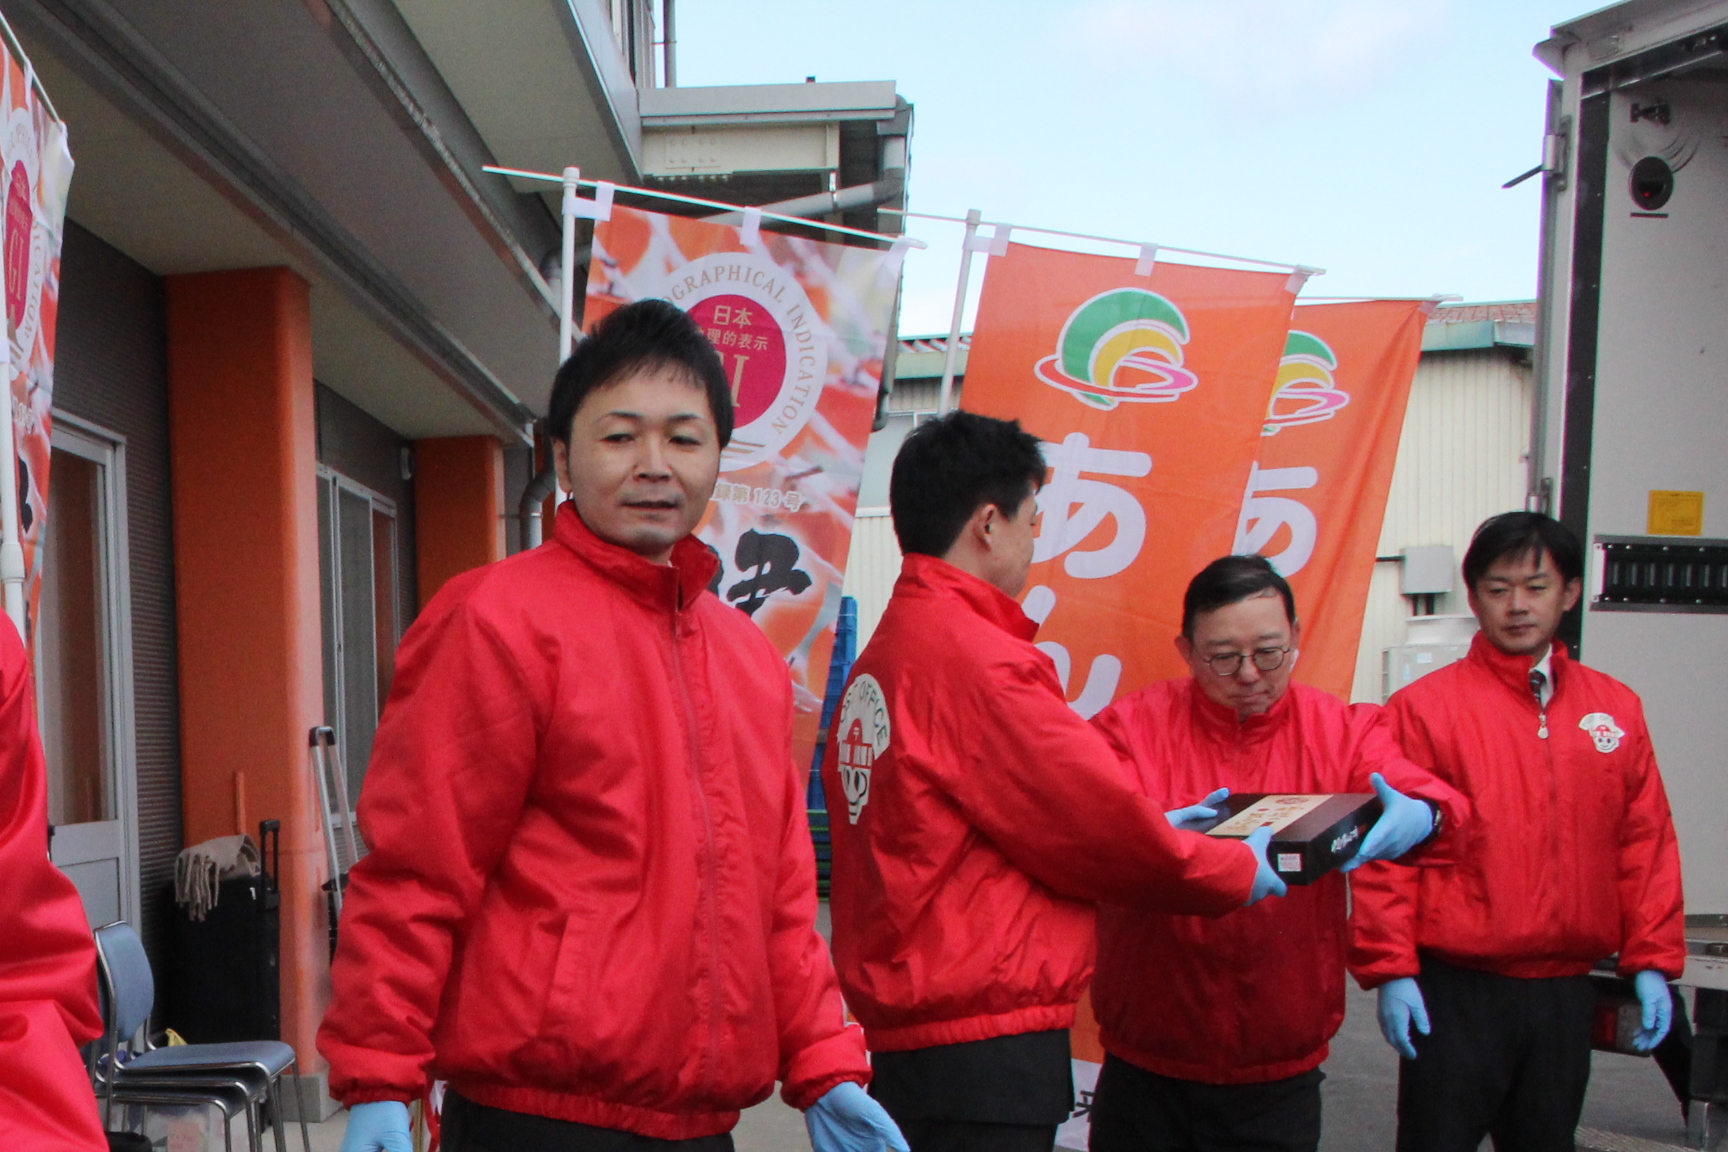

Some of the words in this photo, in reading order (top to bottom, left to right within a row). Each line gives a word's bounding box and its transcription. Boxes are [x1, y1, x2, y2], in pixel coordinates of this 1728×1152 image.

[713, 304, 753, 330] 日本
[699, 326, 770, 351] 理的表示
[772, 302, 816, 435] INDICATION
